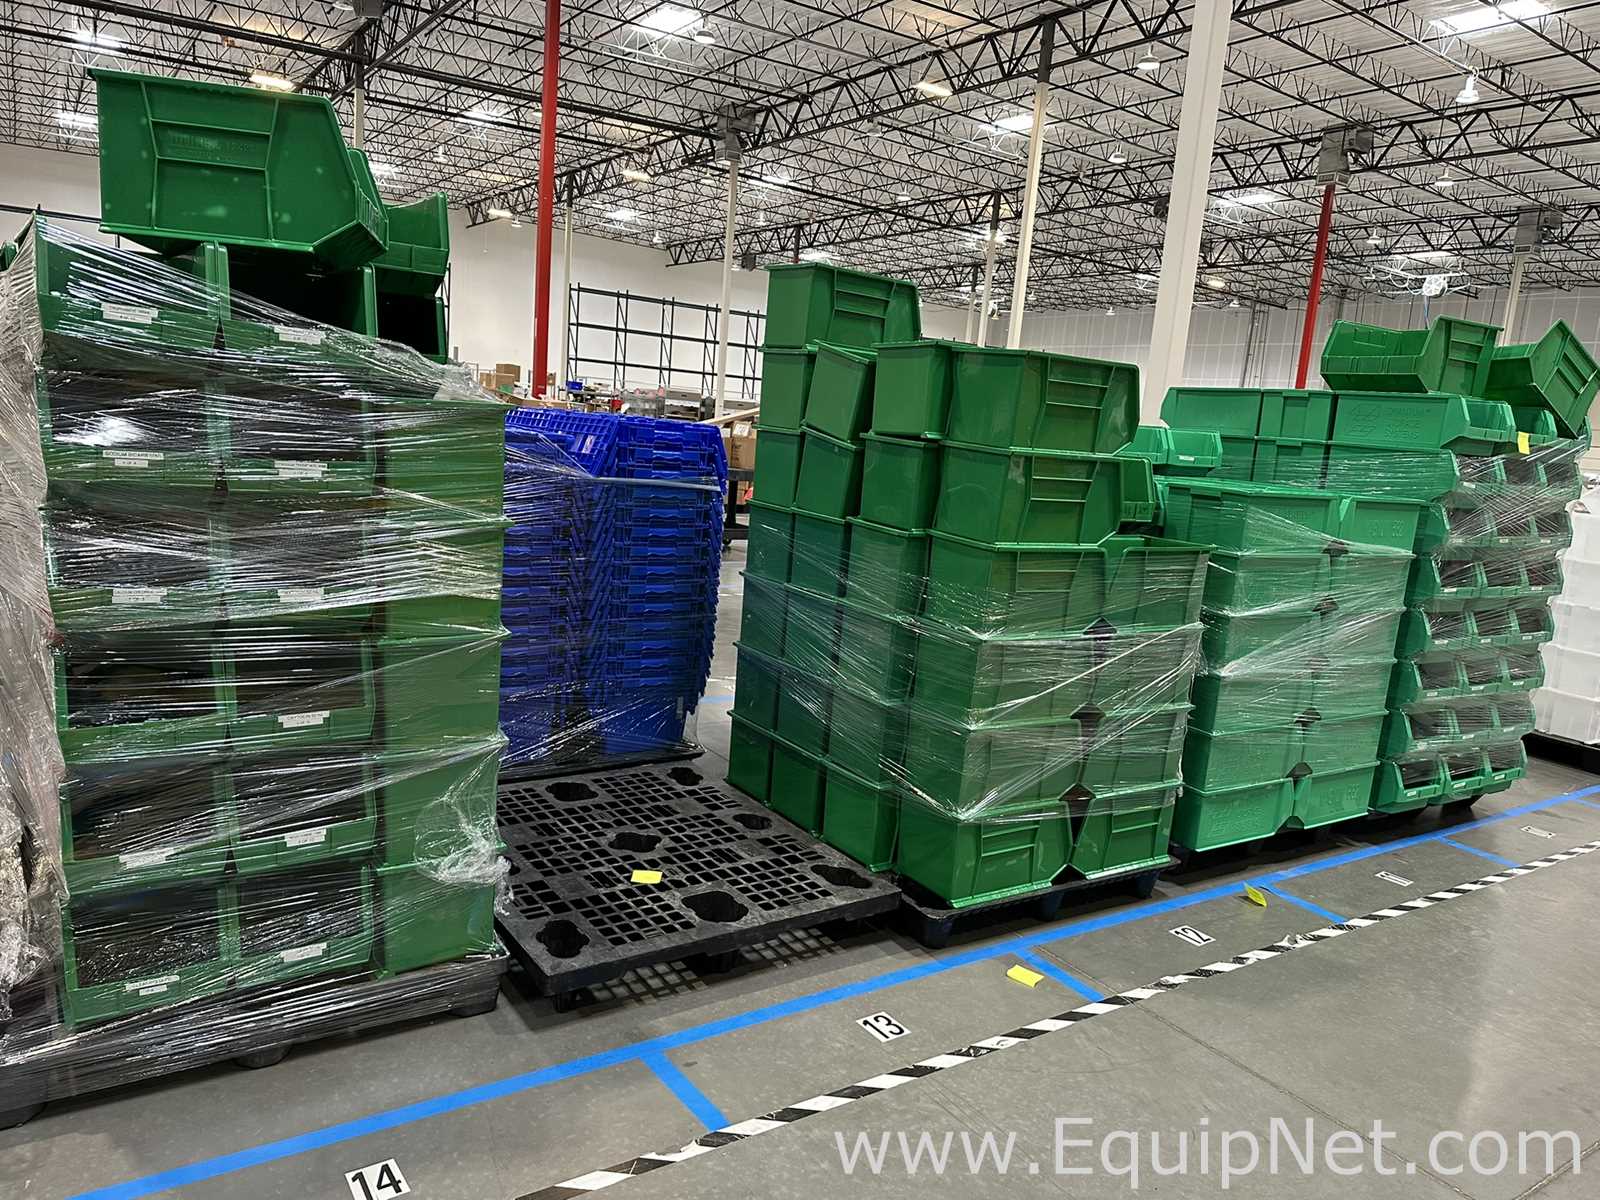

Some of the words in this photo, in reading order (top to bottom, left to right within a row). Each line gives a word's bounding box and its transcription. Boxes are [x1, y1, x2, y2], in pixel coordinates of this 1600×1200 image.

[1174, 927, 1212, 944] 12
[862, 1015, 905, 1039] 13
[351, 1163, 402, 1200] 14
